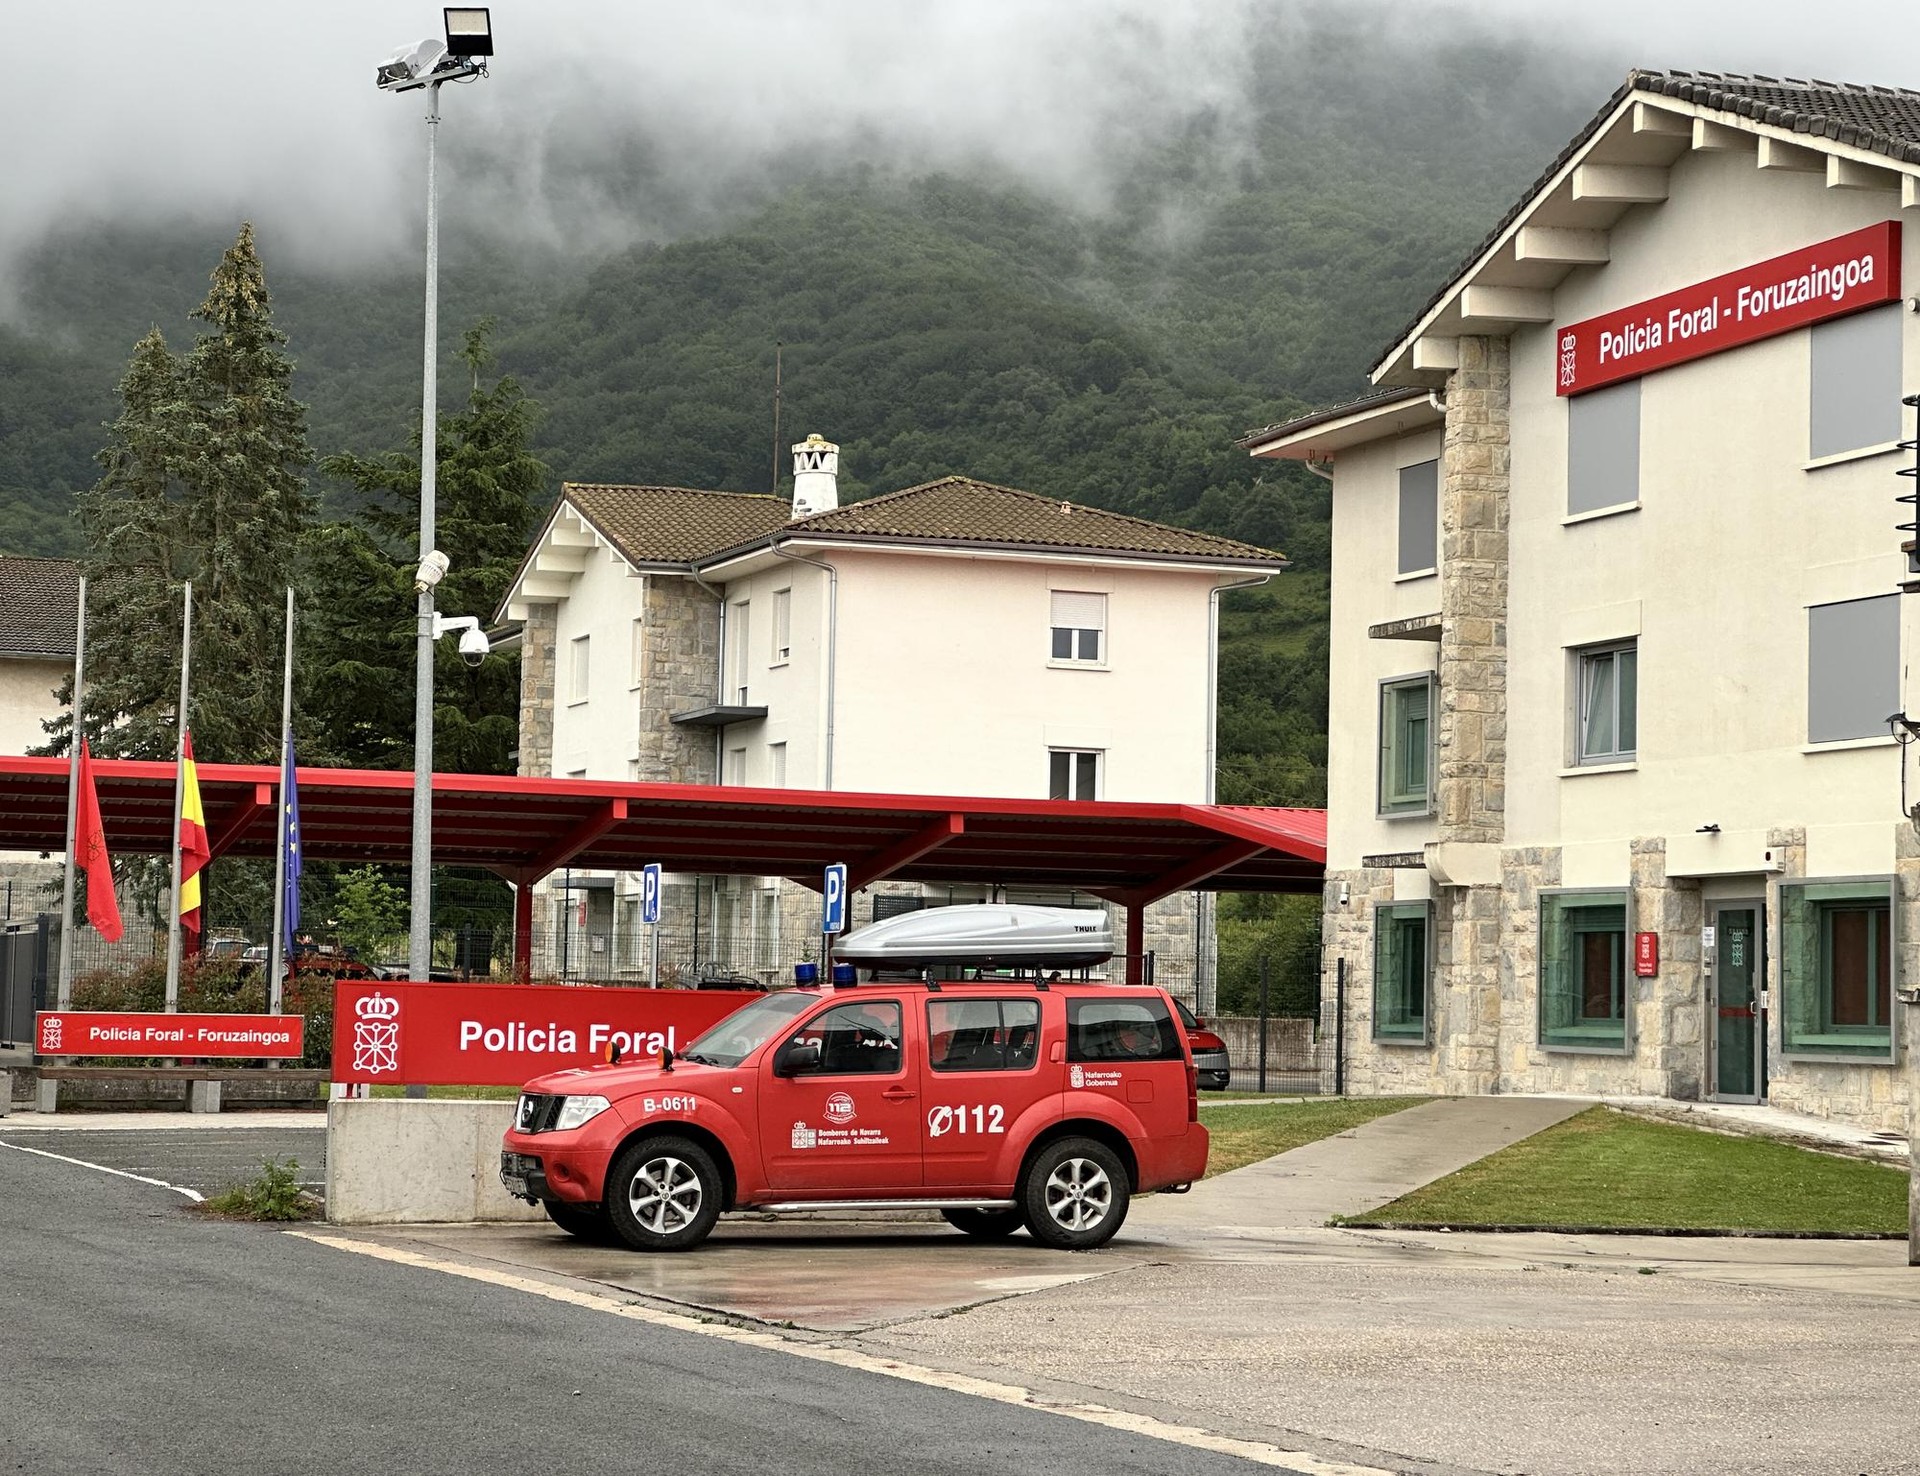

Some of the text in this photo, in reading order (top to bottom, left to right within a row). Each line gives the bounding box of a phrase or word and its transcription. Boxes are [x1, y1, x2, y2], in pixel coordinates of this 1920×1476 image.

[1600, 317, 1662, 364] Policia
[1668, 296, 1718, 343] Foral
[1737, 254, 1874, 321] Foruzaingoa
[646, 872, 655, 916] P
[826, 871, 840, 922] P
[90, 1027, 140, 1040] Policia
[146, 1028, 183, 1041] Foral
[198, 1029, 289, 1045] Foruzaingoa
[461, 1021, 675, 1055] Policia Foral
[643, 1097, 696, 1112] B-0611
[829, 1103, 852, 1112] 112
[954, 1104, 1004, 1133] 112
[818, 1129, 848, 1137] Bomberos
[859, 1128, 881, 1136] Navarra
